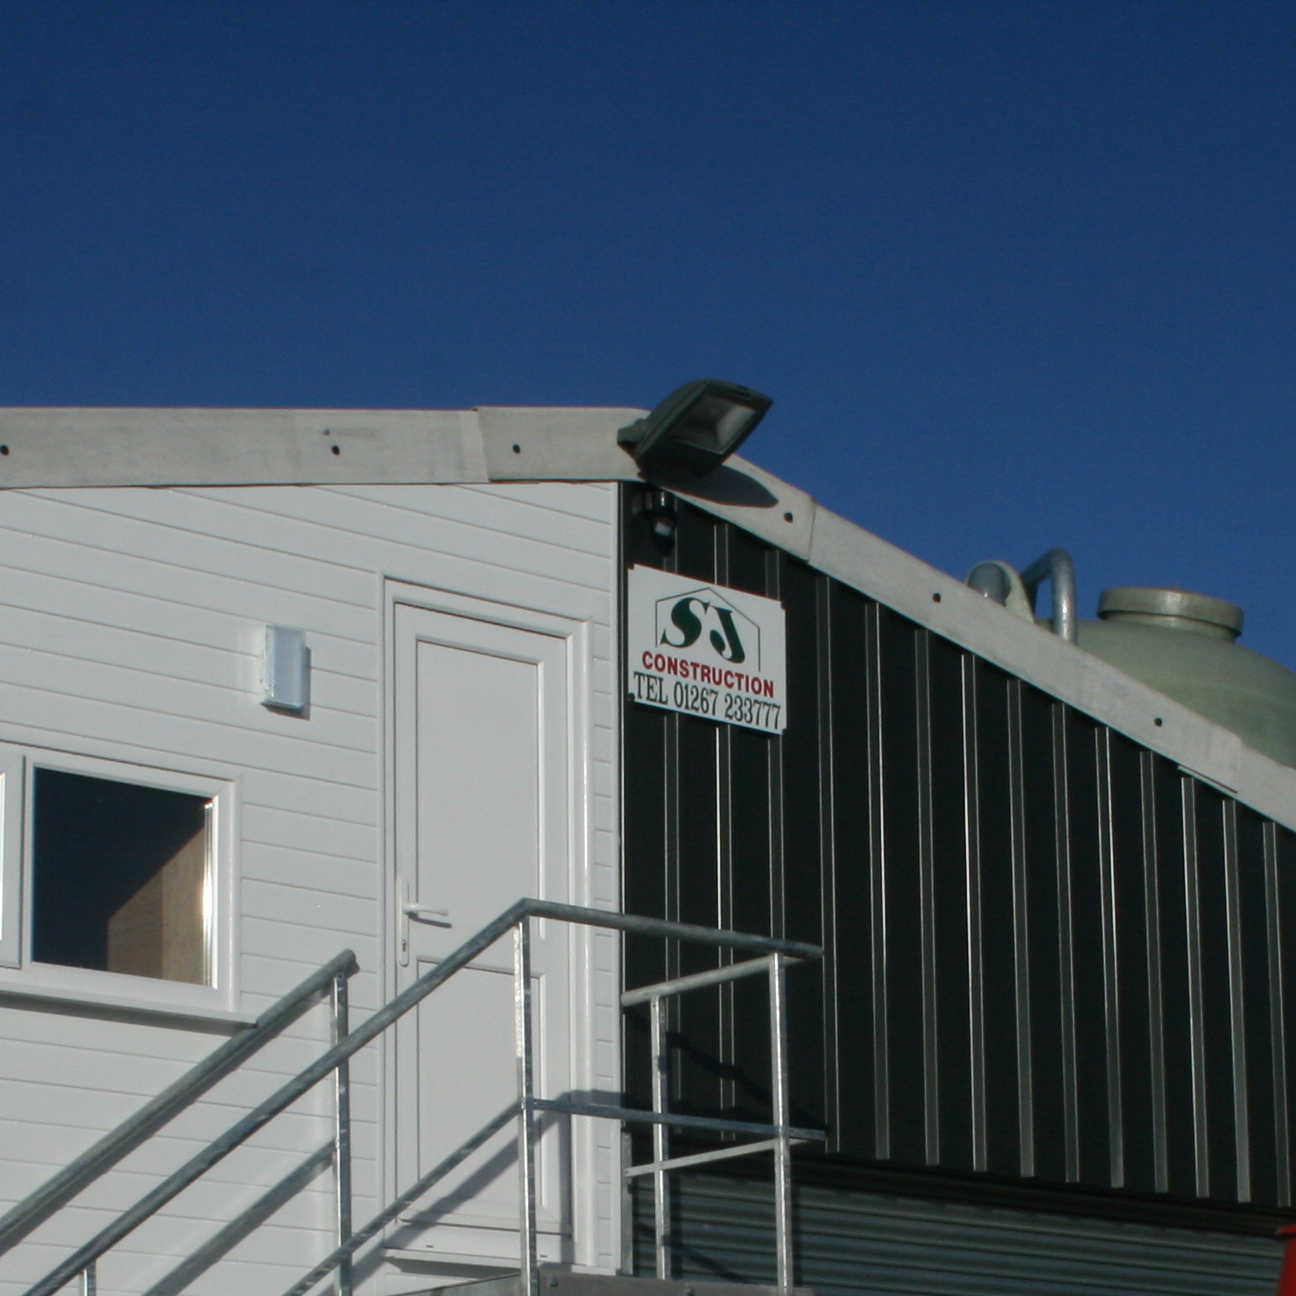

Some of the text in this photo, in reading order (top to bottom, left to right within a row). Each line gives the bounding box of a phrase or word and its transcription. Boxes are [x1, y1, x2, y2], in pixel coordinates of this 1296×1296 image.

[659, 596, 746, 664] SJ
[633, 671, 781, 730] TEL 01267 233777
[641, 651, 774, 699] CONSTRUCTION
